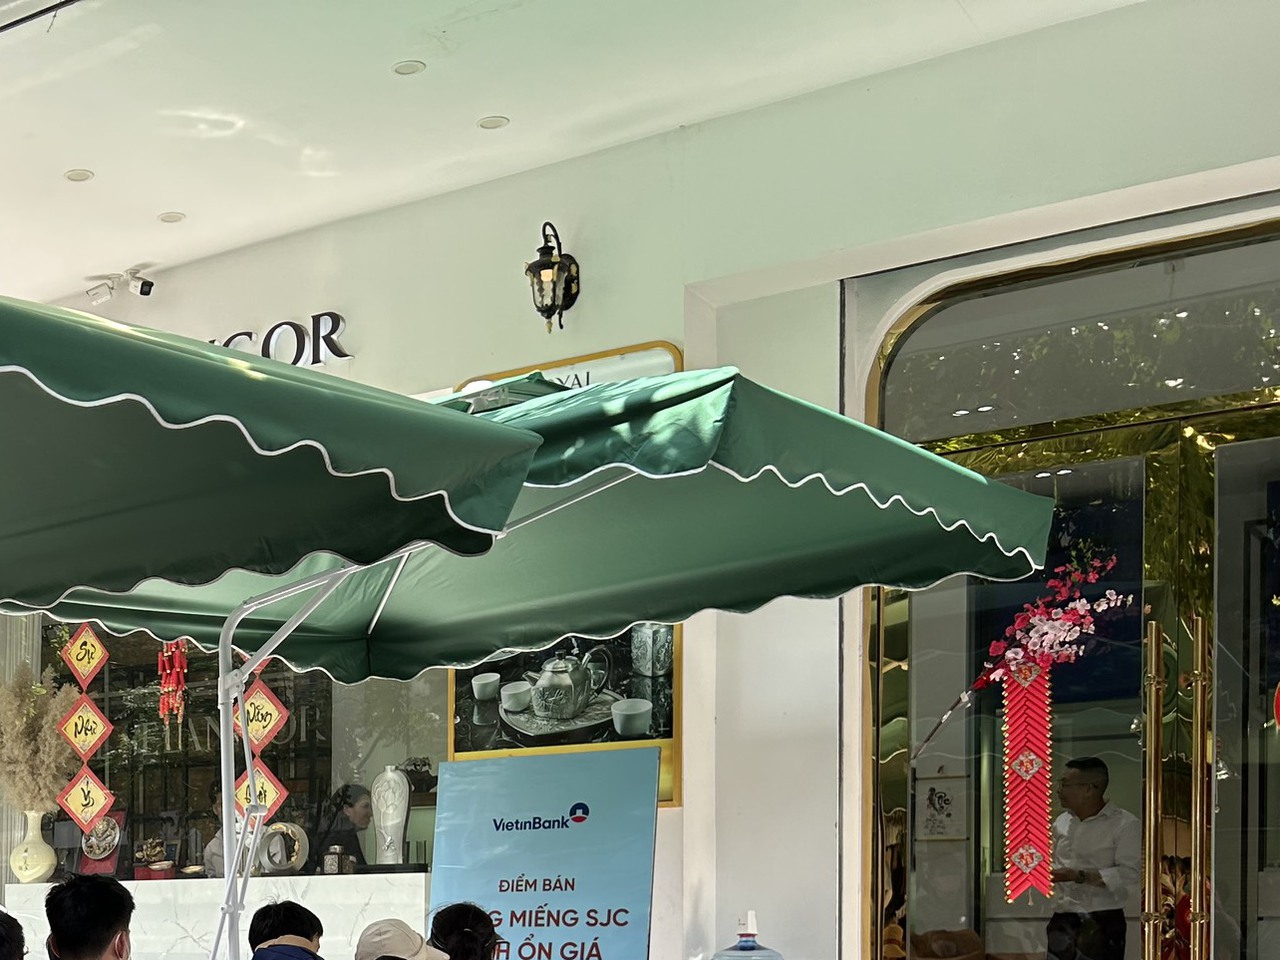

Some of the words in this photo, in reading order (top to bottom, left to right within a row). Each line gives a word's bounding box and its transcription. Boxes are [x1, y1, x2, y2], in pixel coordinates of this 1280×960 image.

[492, 816, 570, 832] VietinBank
[498, 873, 538, 892] ĐIỂM
[542, 875, 575, 892] BÁN
[509, 903, 579, 928] MIẾNG
[585, 908, 630, 927] SJC
[517, 933, 553, 960] ỔN
[559, 937, 602, 960] GIÁ
